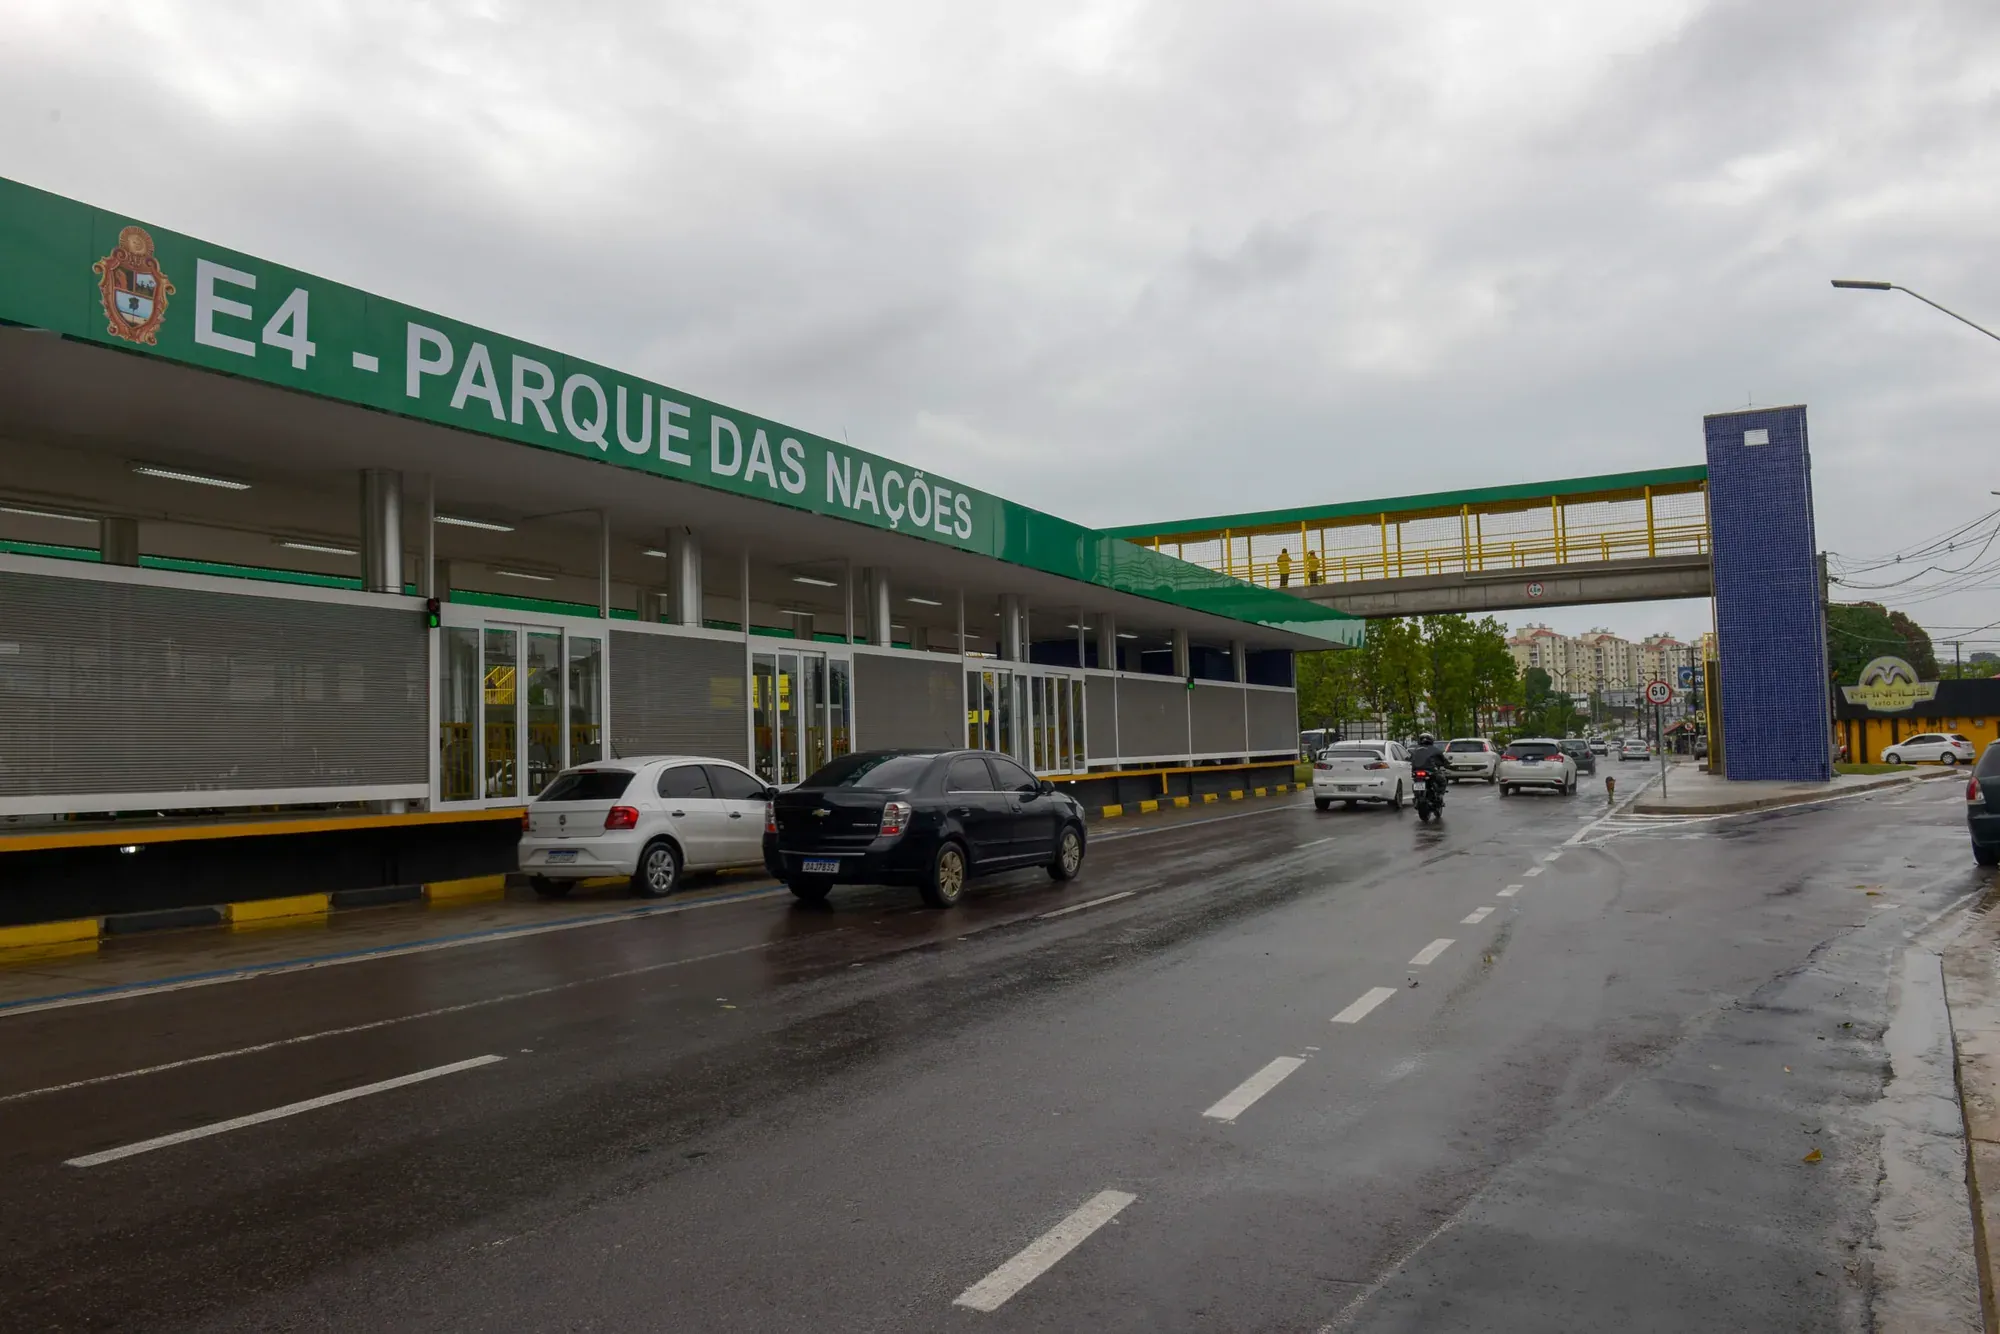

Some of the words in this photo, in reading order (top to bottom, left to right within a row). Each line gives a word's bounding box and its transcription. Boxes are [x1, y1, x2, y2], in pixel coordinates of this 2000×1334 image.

[194, 257, 316, 370] E4
[353, 352, 379, 373] -
[405, 321, 692, 467] PARQUE
[710, 414, 807, 495] DAS
[826, 450, 973, 540] NAÇÕES
[1651, 686, 1666, 696] 60
[1850, 687, 1930, 699] MANAUS
